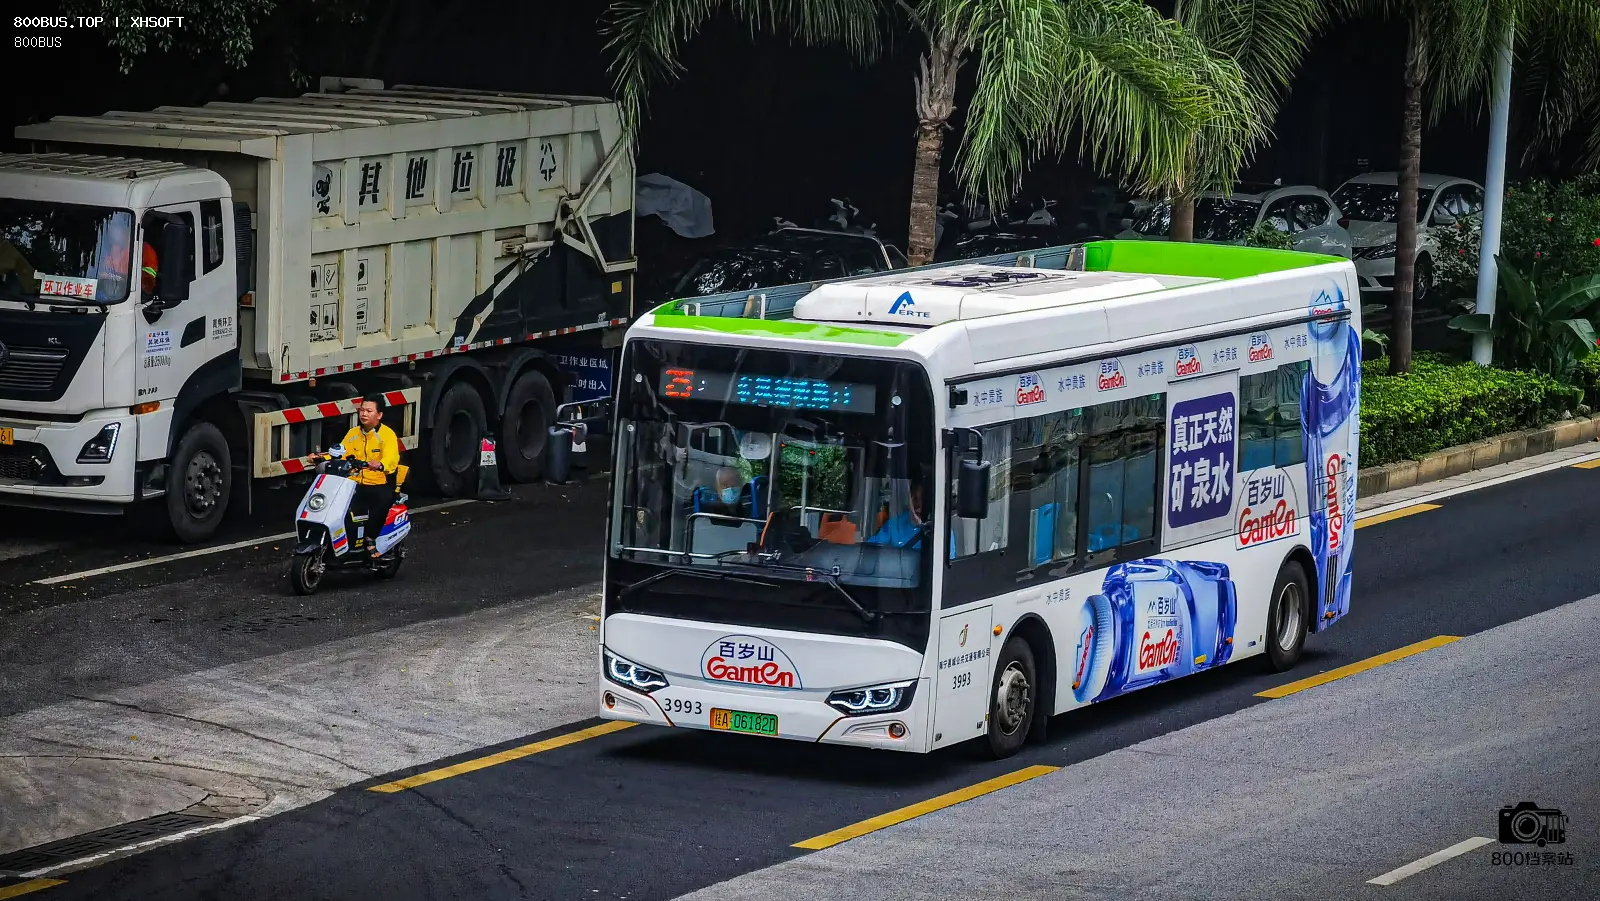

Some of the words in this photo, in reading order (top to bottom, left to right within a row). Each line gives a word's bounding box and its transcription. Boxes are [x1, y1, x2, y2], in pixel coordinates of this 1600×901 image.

[44, 279, 94, 298] 环卫作业车
[1212, 347, 1238, 364] 水中贵族
[1249, 343, 1273, 362] Ganten
[1137, 360, 1164, 378] 水中贵族
[1176, 357, 1201, 376] Ganten
[568, 379, 607, 391] 时出入
[1057, 374, 1086, 393] 水中贵族
[1098, 371, 1125, 390] Ganten
[973, 388, 1003, 407] 水中贵族
[1016, 385, 1045, 405] Ganten
[1173, 406, 1233, 456] 真正天然
[1171, 452, 1231, 513] 矿泉水
[1248, 474, 1285, 507] 百岁山
[1326, 453, 1342, 549] Ganten
[1239, 499, 1295, 546] Ganten
[1157, 597, 1177, 615] 百岁山
[719, 641, 774, 662] 百岁山
[1139, 628, 1178, 671] Ganten
[707, 656, 794, 688] Ganten
[952, 671, 971, 690] 3993
[664, 698, 703, 715] 3993
